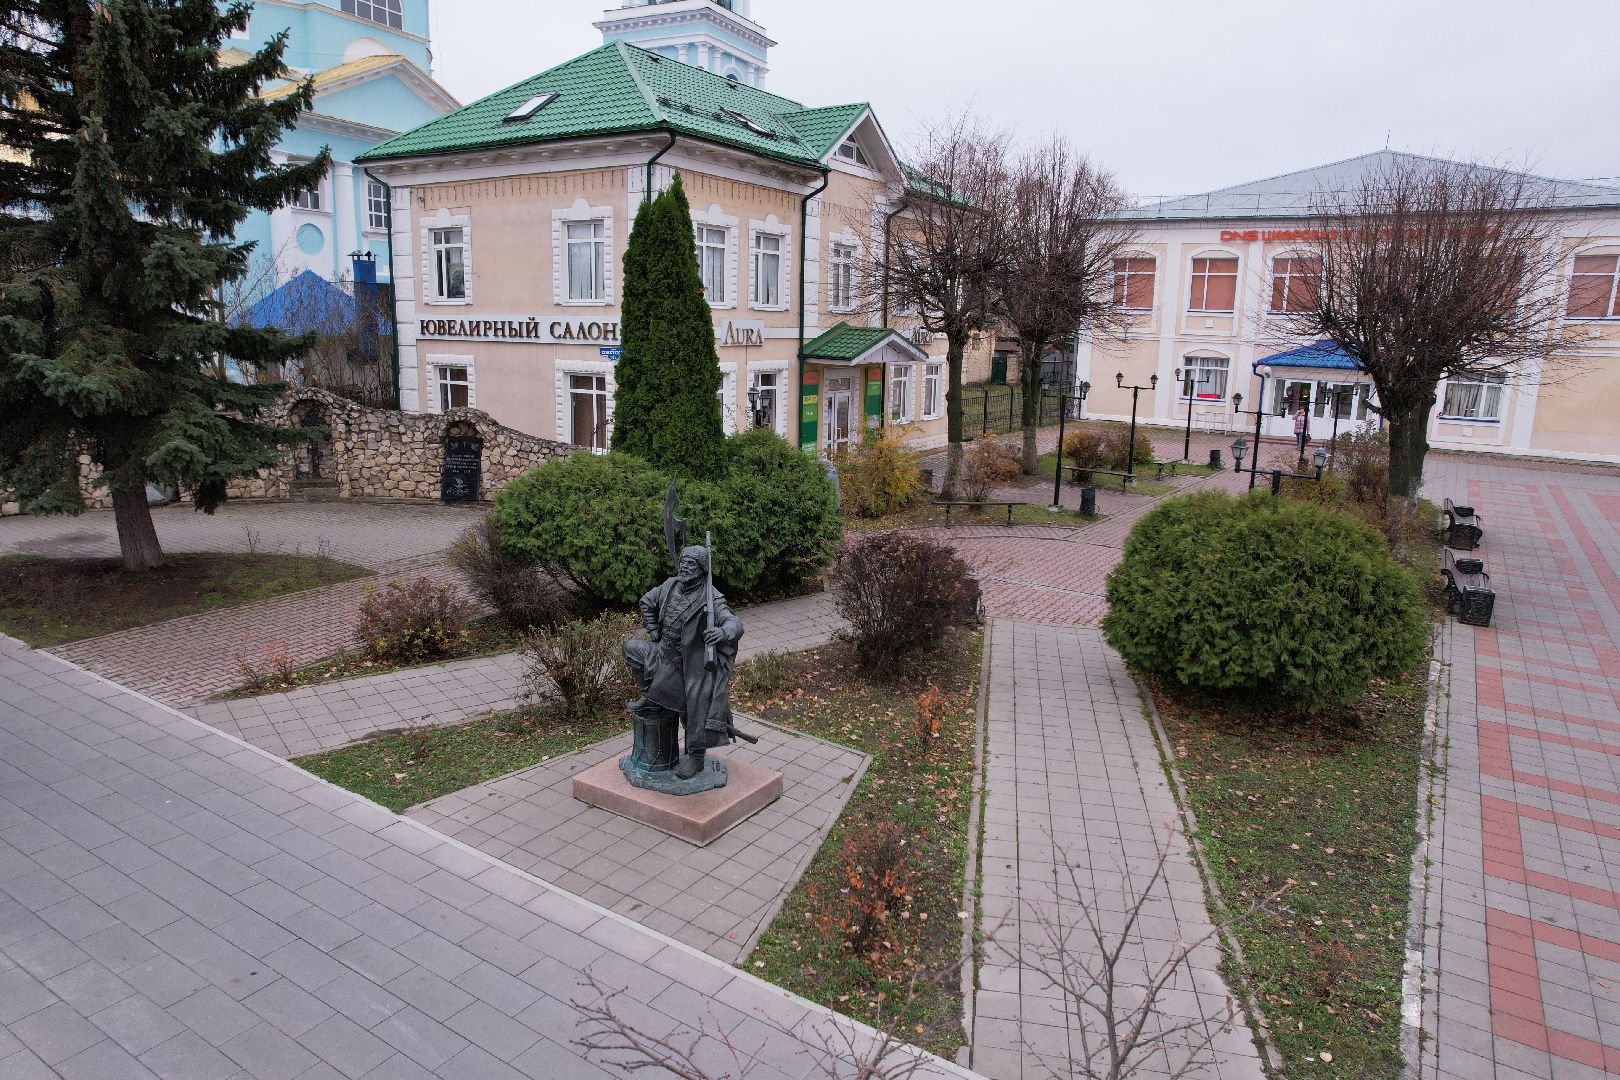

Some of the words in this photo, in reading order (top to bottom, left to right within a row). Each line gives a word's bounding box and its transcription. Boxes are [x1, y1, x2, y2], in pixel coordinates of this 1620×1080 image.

[1220, 230, 1258, 241] DNS
[420, 317, 540, 339] ЮВЕЛИРНЫЙ
[550, 321, 618, 341] САЛОН
[724, 321, 764, 345] AURA
